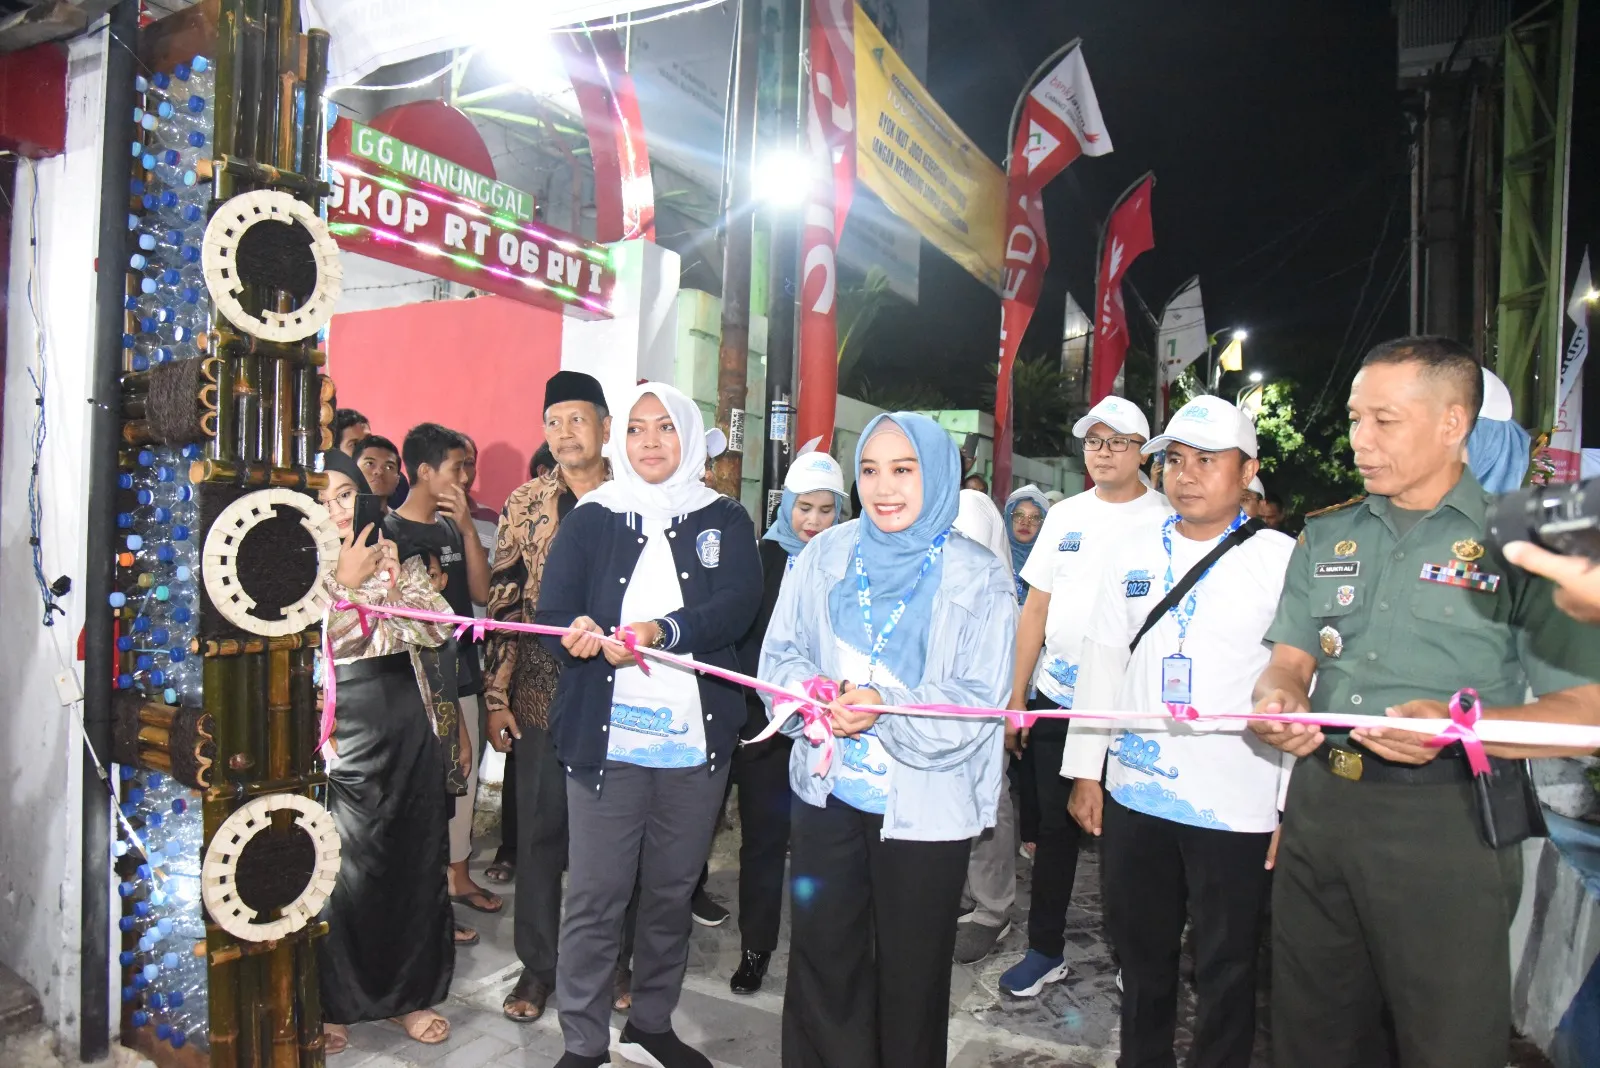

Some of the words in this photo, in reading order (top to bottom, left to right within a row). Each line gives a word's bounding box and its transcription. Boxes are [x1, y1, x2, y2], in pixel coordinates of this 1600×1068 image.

[358, 128, 393, 165] GG
[401, 145, 529, 219] MANUNGGAL
[444, 213, 491, 255] RT
[499, 232, 540, 273] 06
[547, 250, 582, 288] RW
[1059, 541, 1080, 551] 2023
[1127, 582, 1149, 596] 2023
